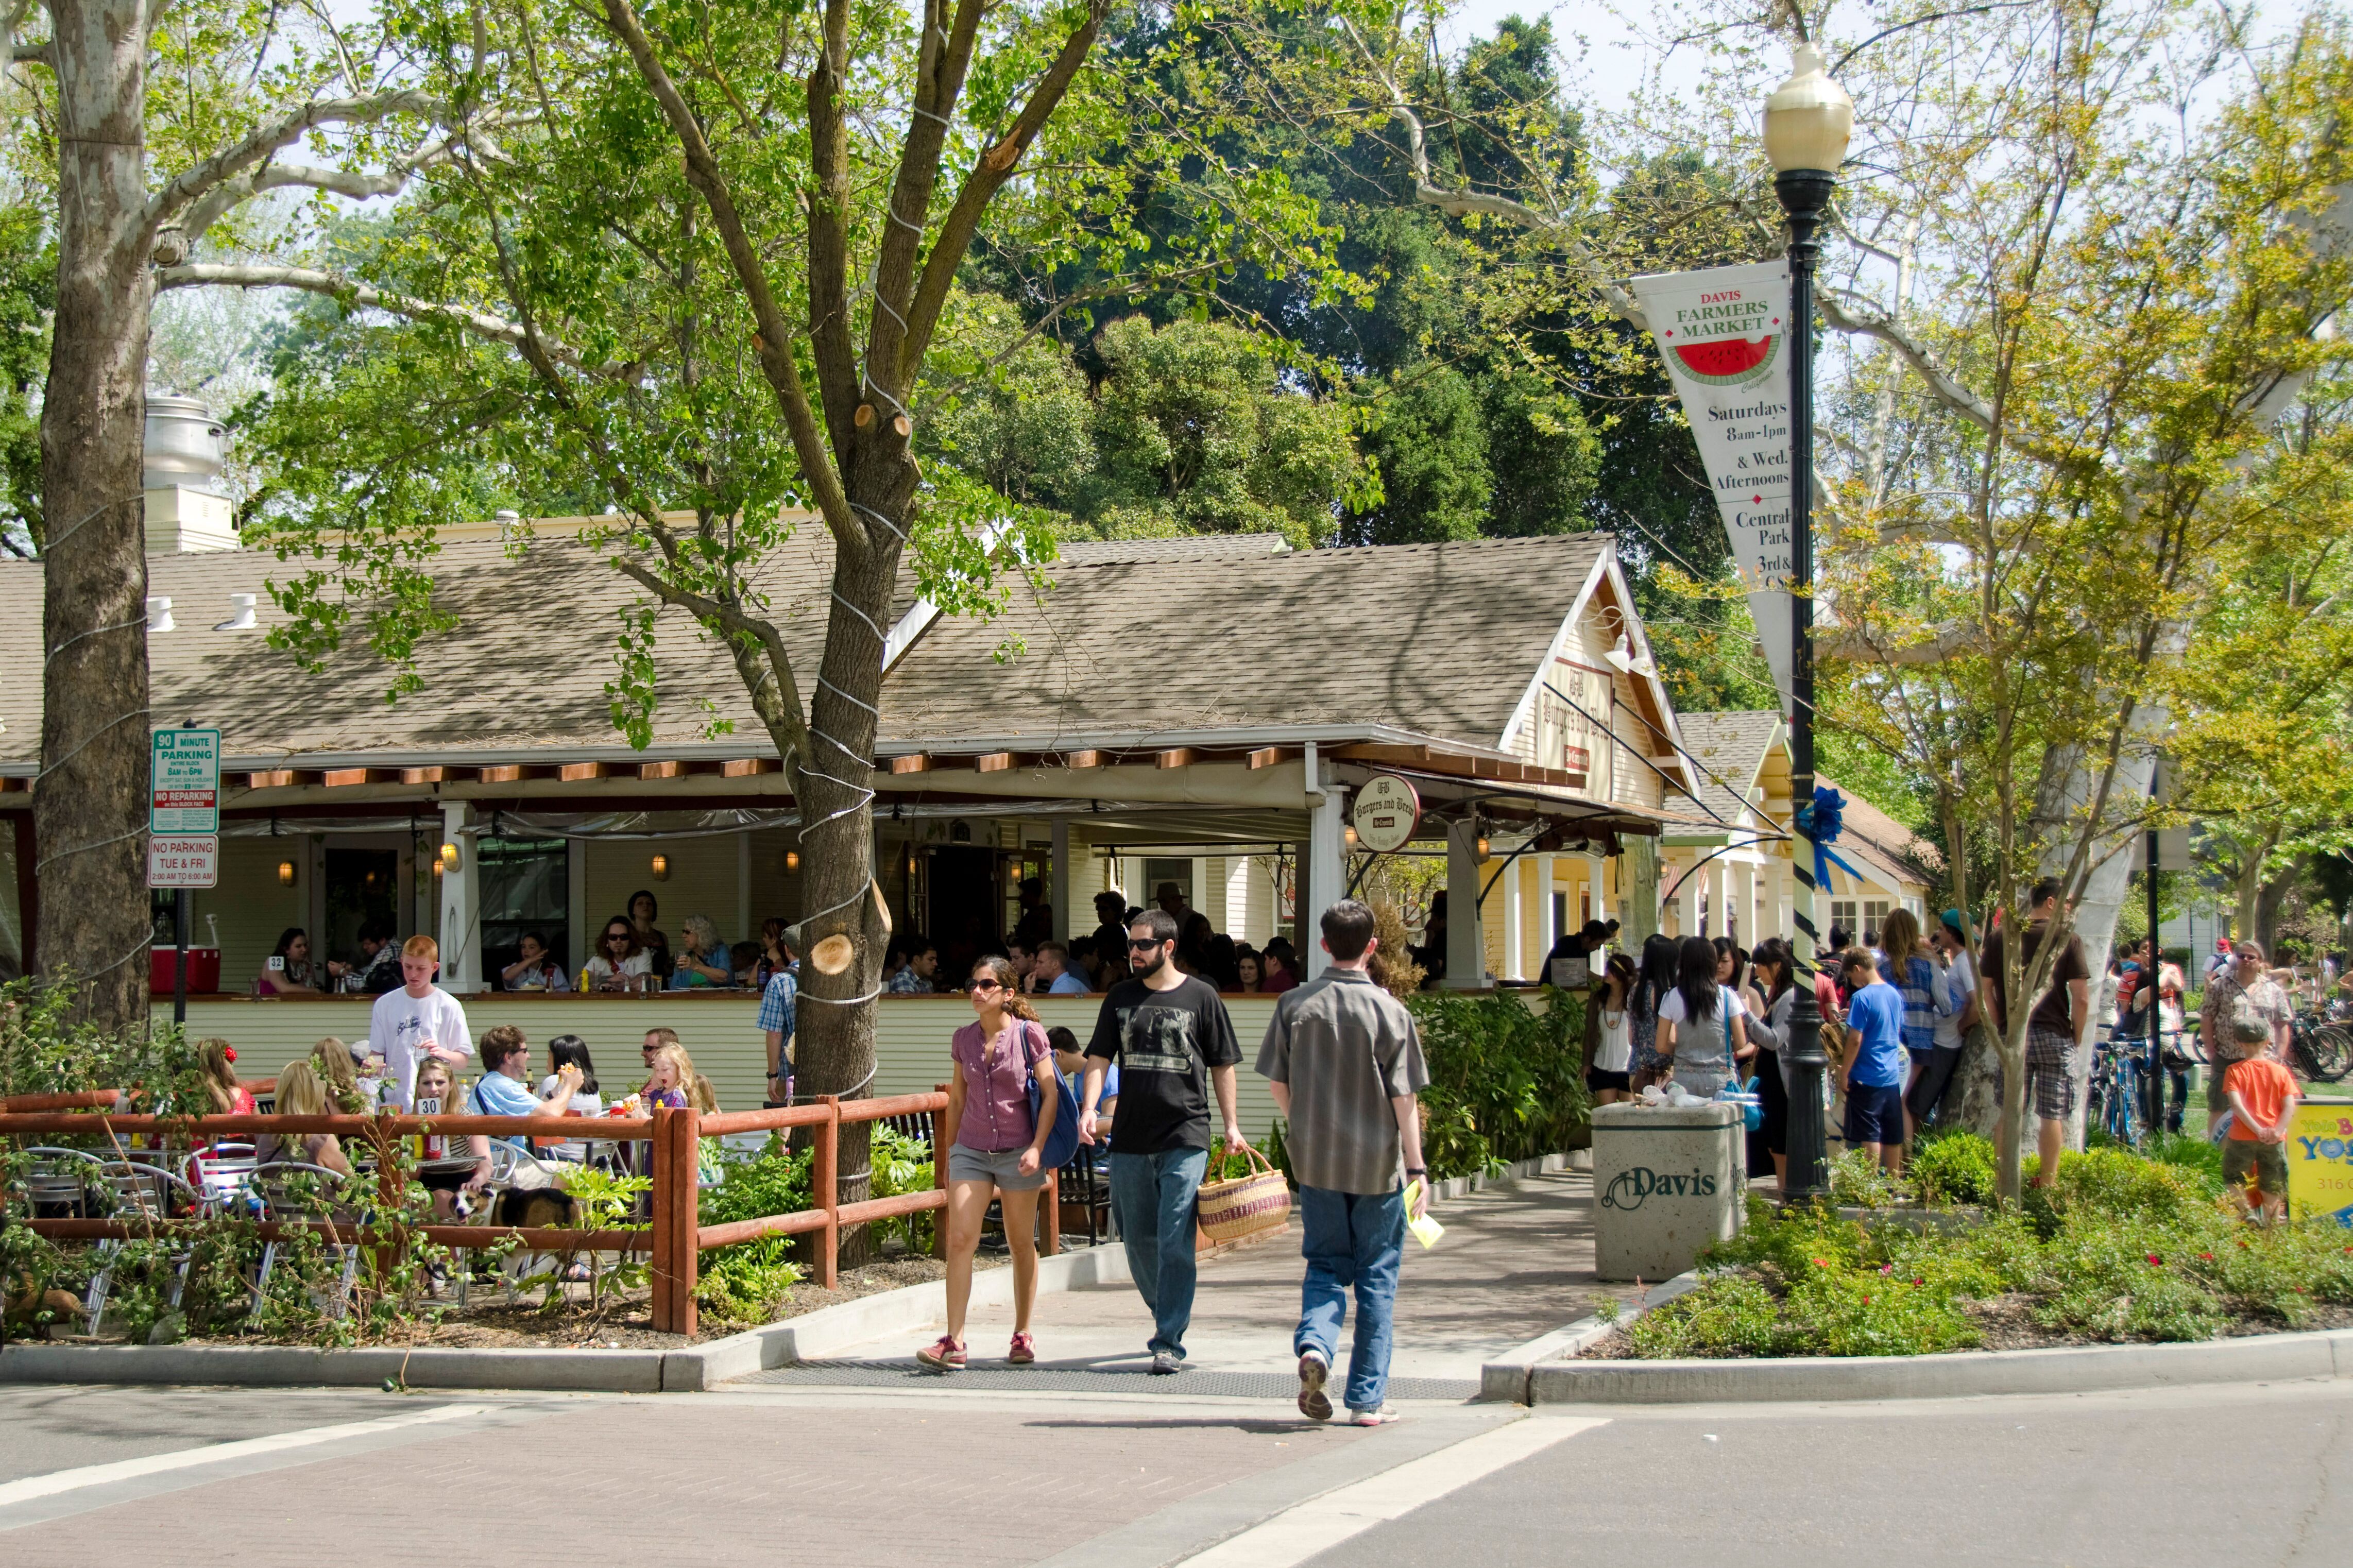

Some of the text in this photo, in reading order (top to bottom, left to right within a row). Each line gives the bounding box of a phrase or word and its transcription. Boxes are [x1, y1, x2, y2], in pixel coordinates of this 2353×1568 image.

[1700, 290, 1741, 304] DAVIS
[1676, 300, 1768, 322] FARMERS
[1681, 316, 1765, 338] MARKET
[1741, 369, 1774, 394] California
[1708, 401, 1787, 422] Saturdays
[1727, 424, 1786, 441] 8am-1pm
[1737, 449, 1788, 469] & Wed.
[1714, 473, 1789, 491] Afternoons
[1736, 508, 1792, 528] Central
[1759, 529, 1790, 546] Park
[1757, 555, 1792, 573] 3rd &
[1543, 692, 1575, 736] Burgers
[1576, 710, 1588, 735] and
[158, 734, 209, 746] 90 MINUTE
[161, 751, 213, 759] PARKING
[189, 767, 202, 775] 6PM
[156, 792, 213, 801] NO REPARKING
[1355, 797, 1414, 822] Burgers and Brew
[153, 843, 213, 853] NO PARKING
[160, 858, 206, 868] TUE & FRI
[271, 958, 281, 966] 32
[422, 1099, 437, 1114] 30
[1631, 1167, 1716, 1196] Davis
[2317, 1178, 2343, 1189] 316
